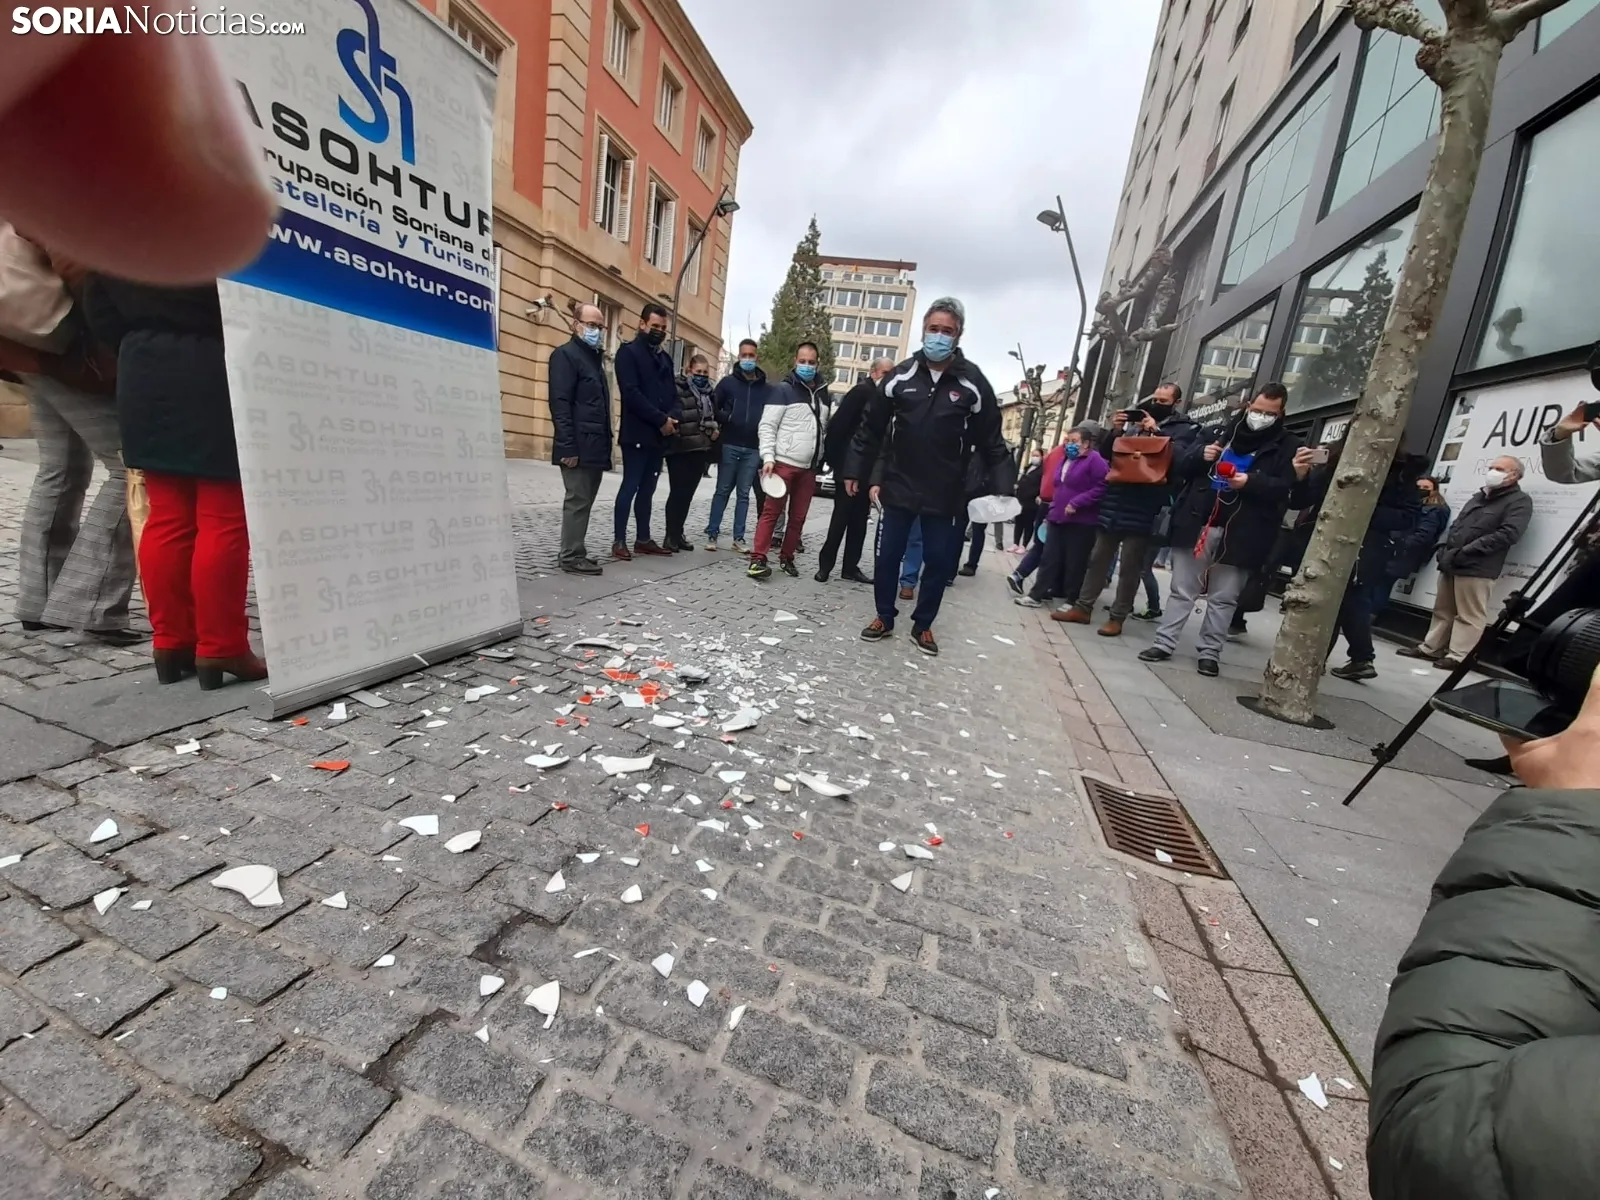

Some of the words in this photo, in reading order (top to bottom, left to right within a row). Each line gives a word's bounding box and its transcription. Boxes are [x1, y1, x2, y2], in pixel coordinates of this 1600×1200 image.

[262, 147, 382, 214] rupación
[391, 204, 474, 254] Soriana
[270, 175, 382, 235] stelería
[396, 230, 409, 250] y
[268, 222, 495, 314] ww.asohtur.com
[252, 351, 398, 391] ASOHTUR
[318, 415, 445, 440] ASOHTUR
[388, 469, 493, 484] ASOHTUR
[276, 519, 414, 546] ASOHTUR
[346, 558, 461, 588] ASOHTUR
